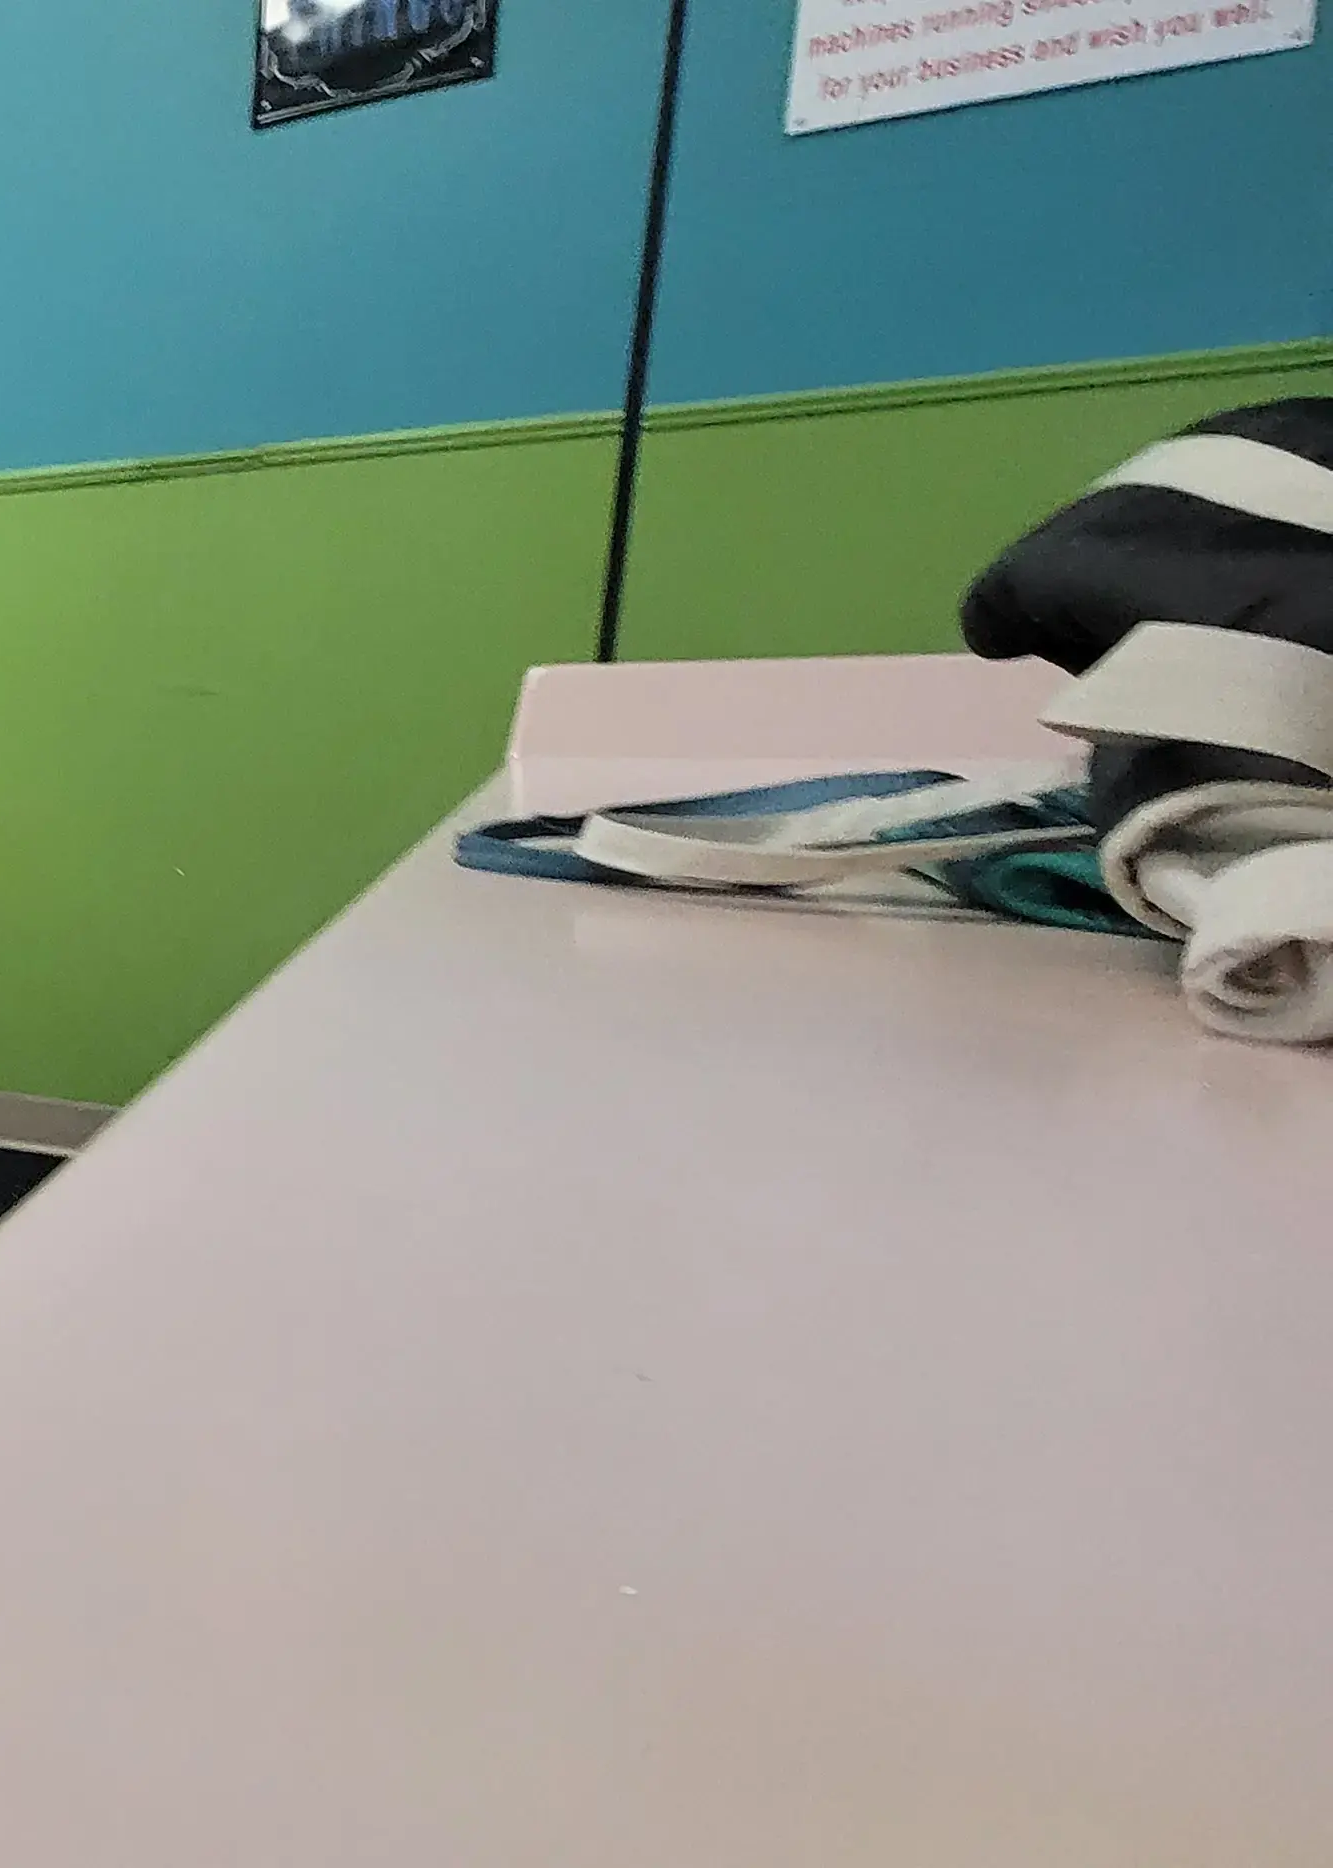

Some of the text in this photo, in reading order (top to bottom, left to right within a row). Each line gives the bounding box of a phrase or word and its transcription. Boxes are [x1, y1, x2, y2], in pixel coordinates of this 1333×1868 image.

[808, 18, 915, 58] machines
[915, 44, 1025, 82] business
[1030, 31, 1079, 62] and
[1088, 17, 1147, 48] wish
